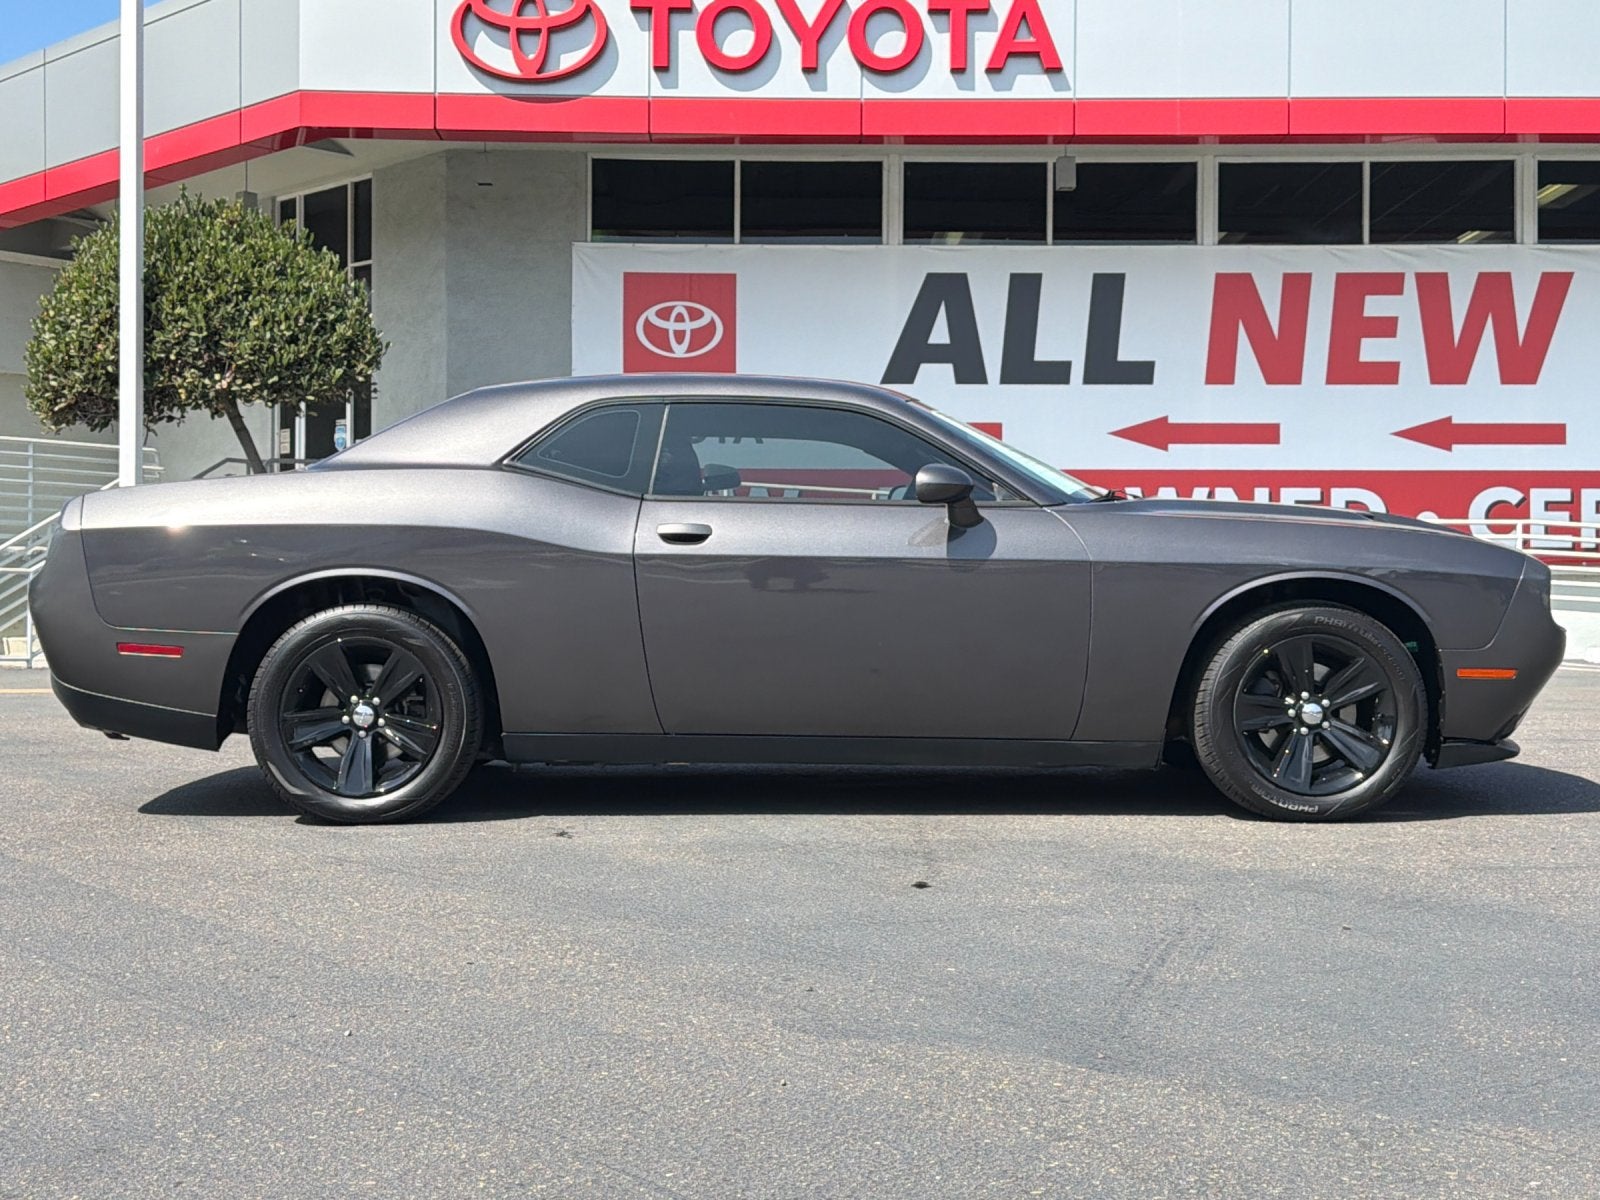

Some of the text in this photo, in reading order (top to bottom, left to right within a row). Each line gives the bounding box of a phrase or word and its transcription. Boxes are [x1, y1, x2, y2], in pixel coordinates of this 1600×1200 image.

[630, 0, 1063, 72] TOYOTA
[880, 272, 1574, 385] ALL NEW
